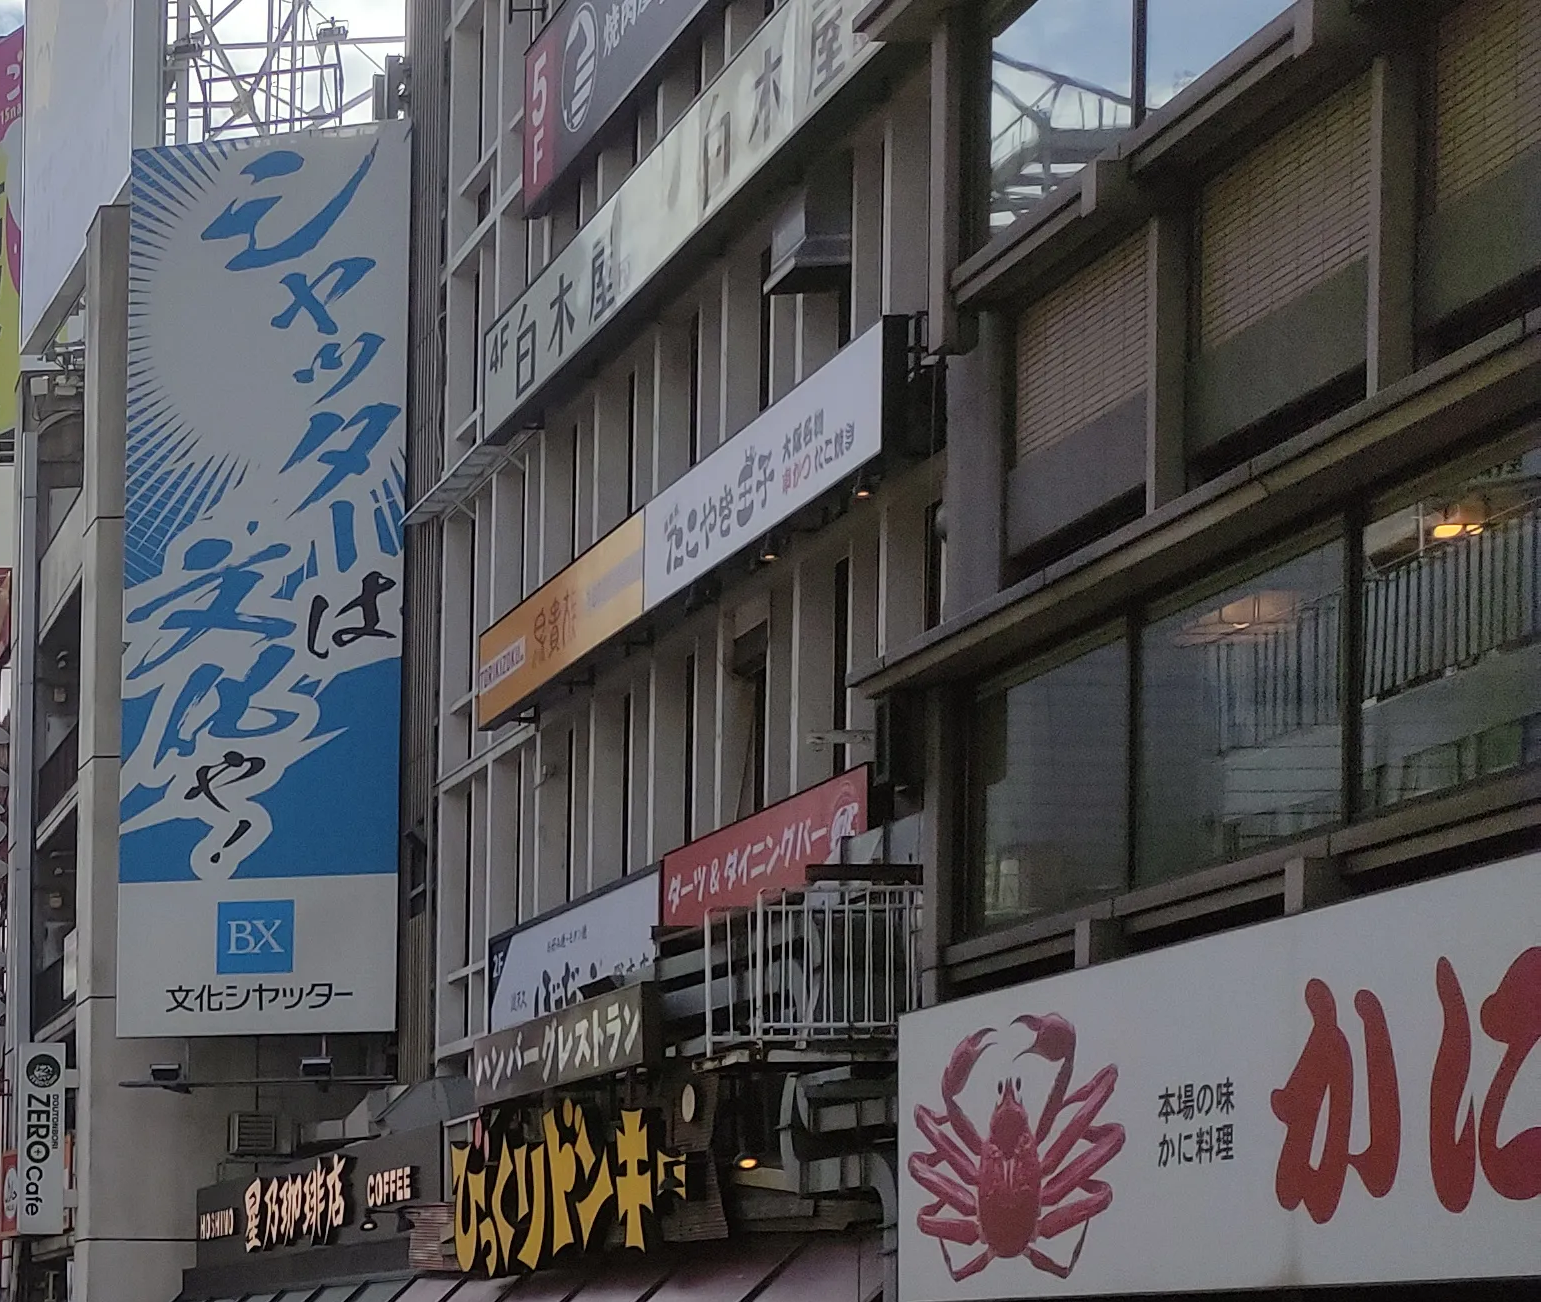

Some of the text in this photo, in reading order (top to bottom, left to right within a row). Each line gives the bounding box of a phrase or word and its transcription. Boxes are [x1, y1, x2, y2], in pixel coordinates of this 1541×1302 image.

[488, 319, 509, 374] 4F
[515, 243, 617, 400] 白木屋
[227, 919, 285, 954] BX
[1157, 1076, 1237, 1120] 本場の味
[1269, 946, 1541, 1225] かに
[26, 1093, 51, 1164] ZERO
[1157, 1123, 1237, 1168] かに料理
[25, 1165, 44, 1216] Cafe
[243, 1153, 347, 1253] 星乃珈琲店
[366, 1165, 412, 1208] COFFEE
[199, 1206, 234, 1241] HOSHINO
